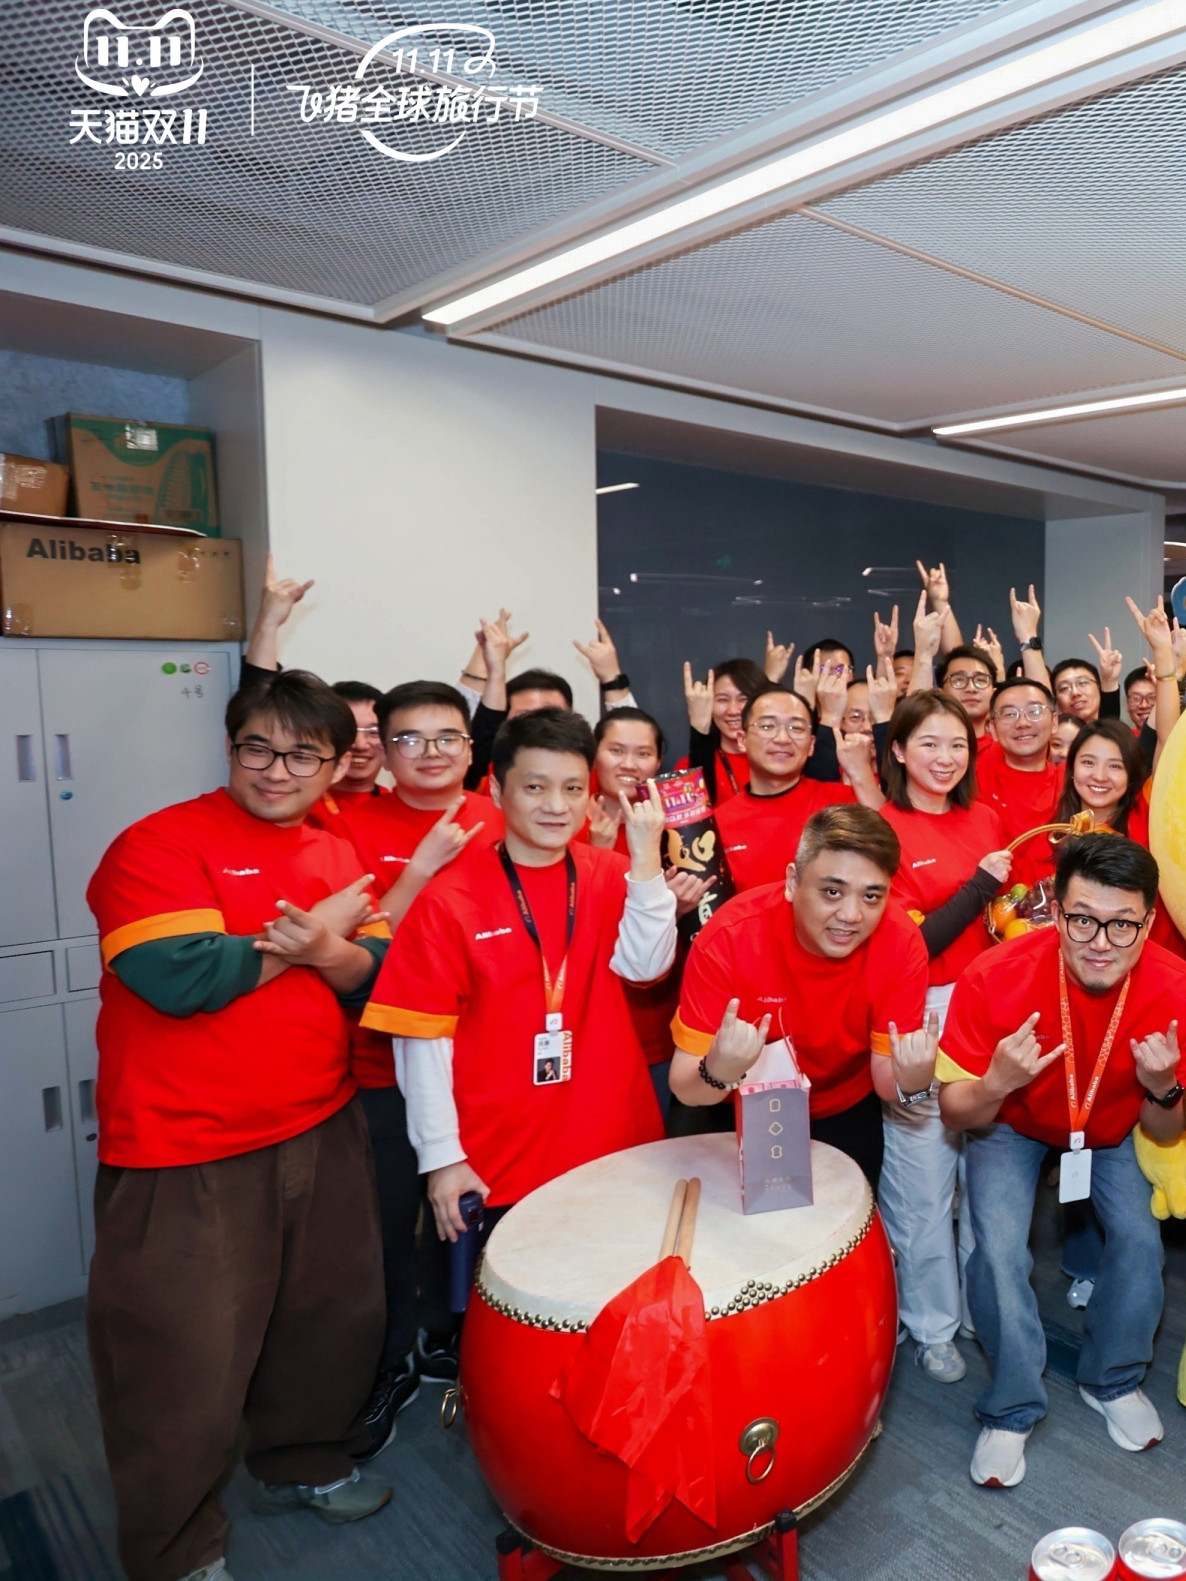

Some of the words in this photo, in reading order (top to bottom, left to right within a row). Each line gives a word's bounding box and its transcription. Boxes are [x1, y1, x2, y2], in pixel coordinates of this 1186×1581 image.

[26, 538, 141, 564] Alibaba
[562, 1032, 572, 1081] Alibaba
[1087, 1075, 1099, 1102] Alibaba
